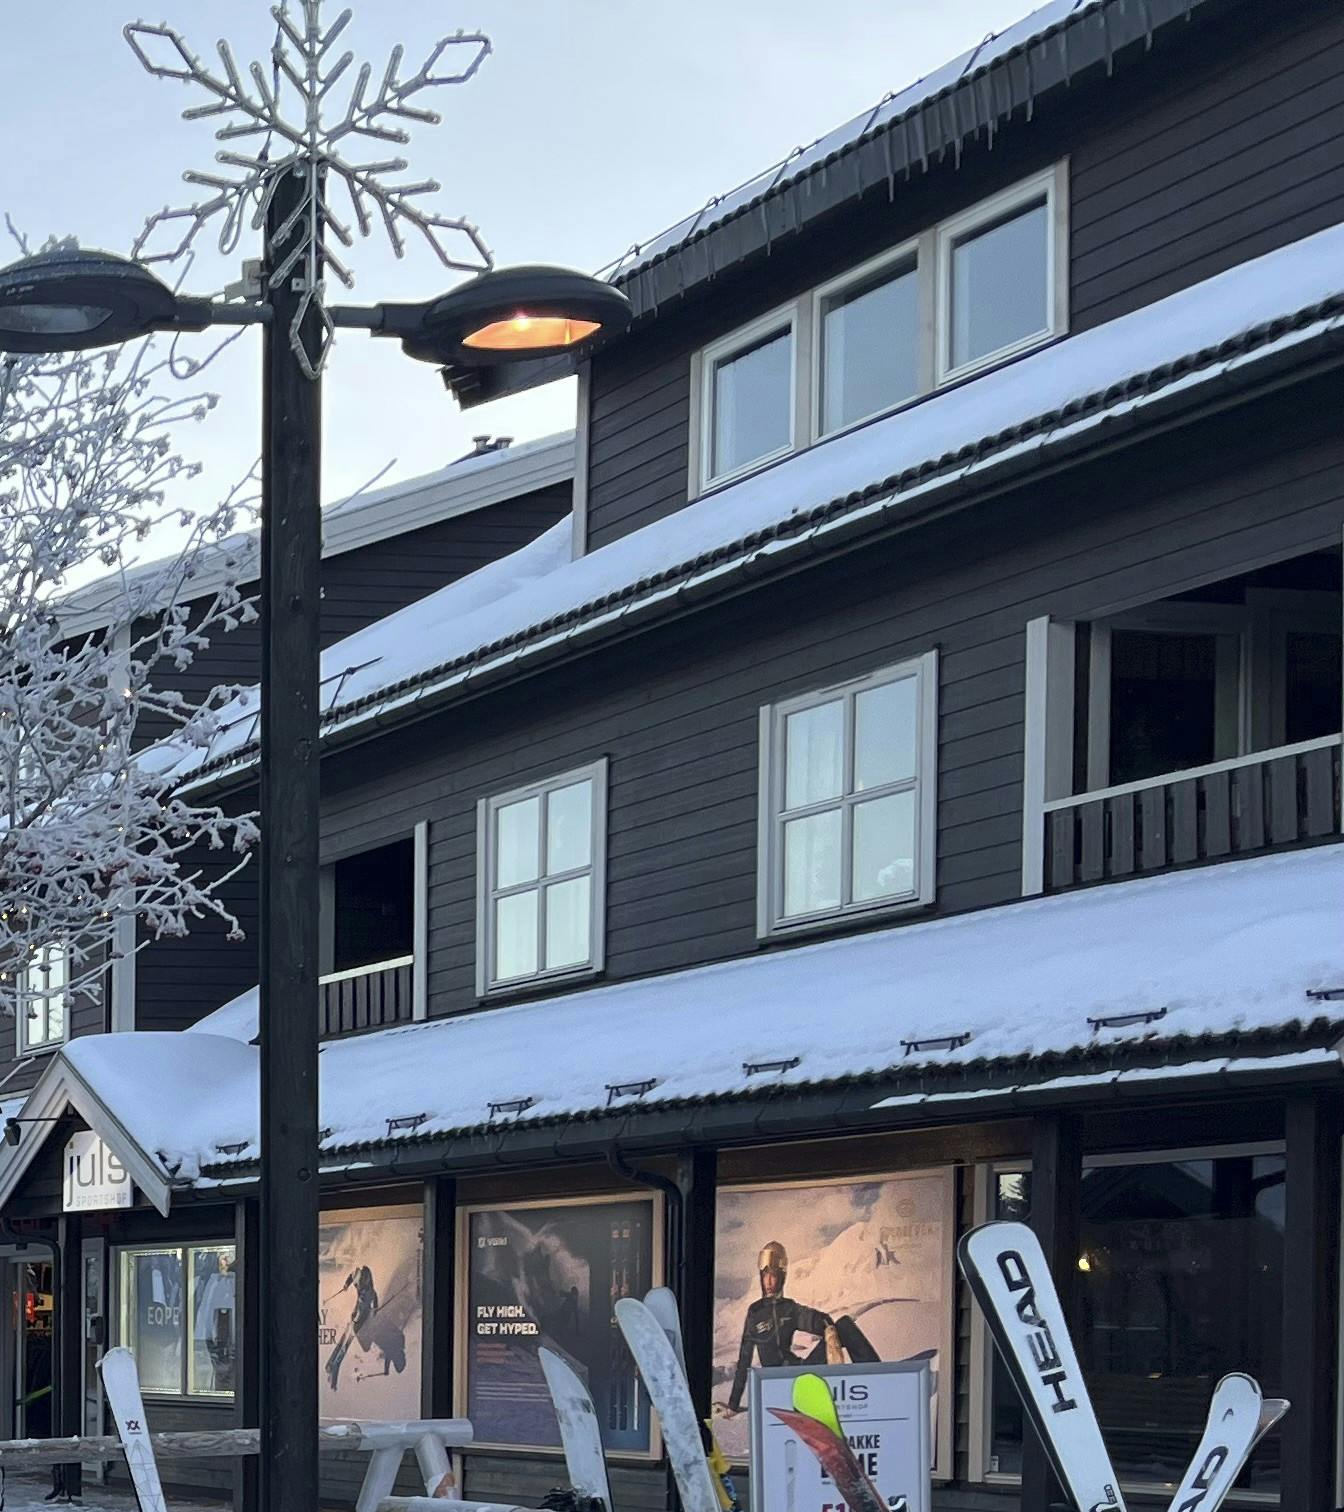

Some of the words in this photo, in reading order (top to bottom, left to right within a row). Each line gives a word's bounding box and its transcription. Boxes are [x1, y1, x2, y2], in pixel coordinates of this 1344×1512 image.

[66, 1139, 127, 1207] juls
[477, 1306, 495, 1317] FLY
[497, 1305, 526, 1317] HIGH.
[477, 1323, 498, 1334] GET
[499, 1323, 539, 1335] HYPED.
[997, 1250, 1078, 1413] HEAD
